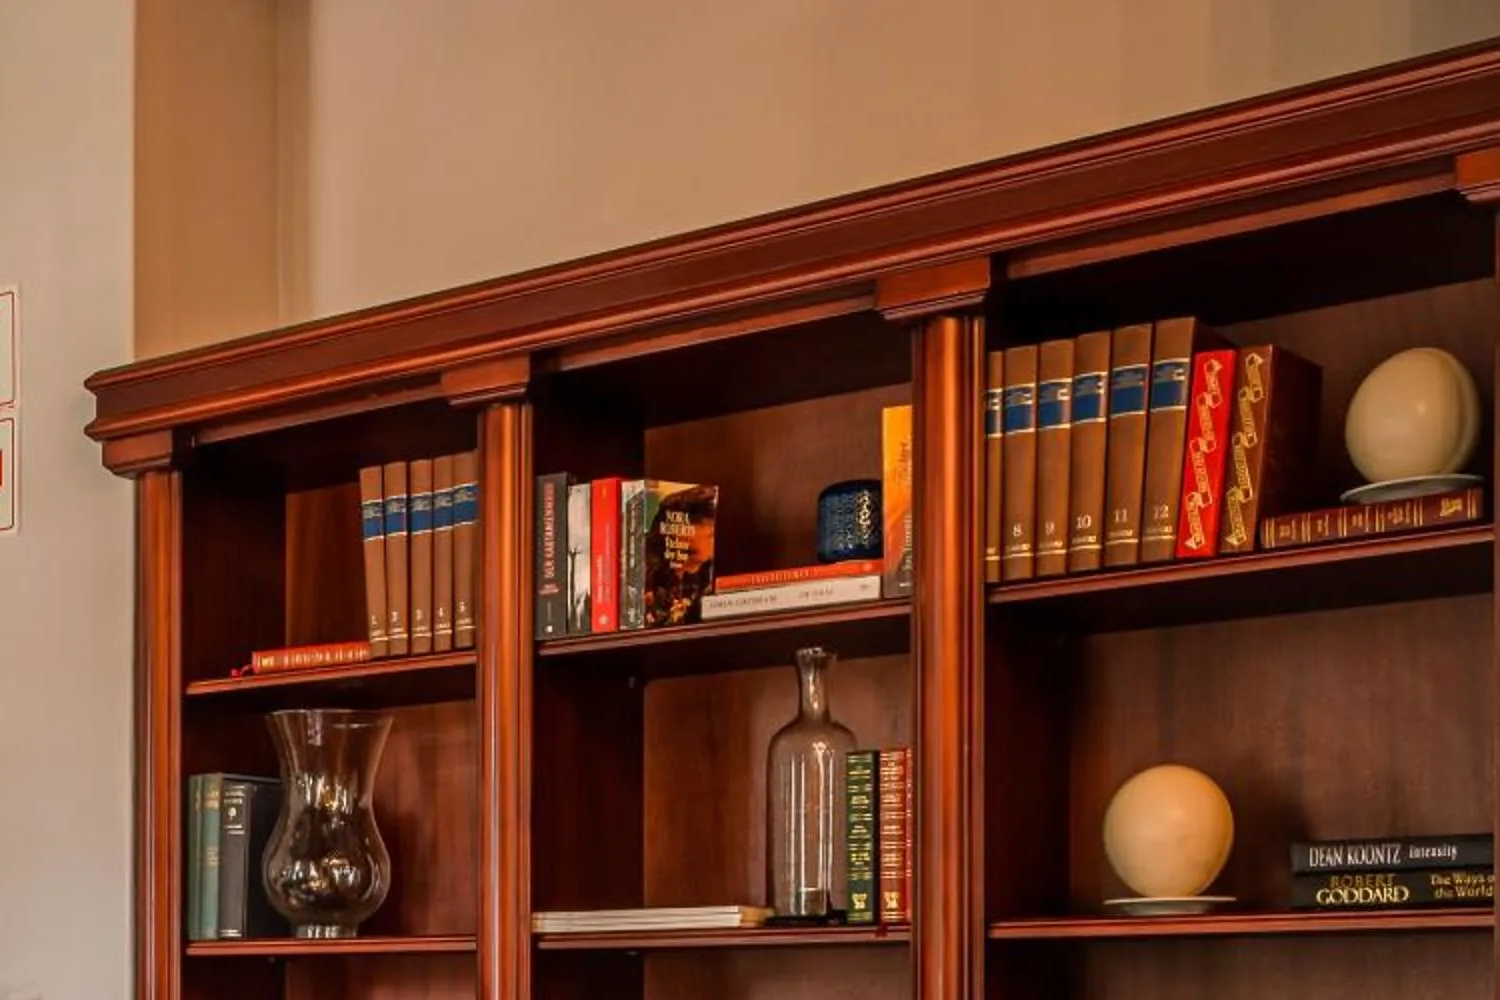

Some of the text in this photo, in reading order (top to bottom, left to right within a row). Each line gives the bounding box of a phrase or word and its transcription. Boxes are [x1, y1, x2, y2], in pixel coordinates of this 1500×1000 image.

[1114, 508, 1128, 523] 11
[1153, 504, 1169, 520] 12
[1012, 522, 1022, 537] 8
[1045, 520, 1055, 535] 9
[1076, 515, 1093, 529] 10
[1309, 846, 1343, 867] DEAN
[1347, 843, 1401, 866] KOONTZ
[1330, 874, 1394, 887] ROBERT
[1316, 885, 1410, 905] GODDARD
